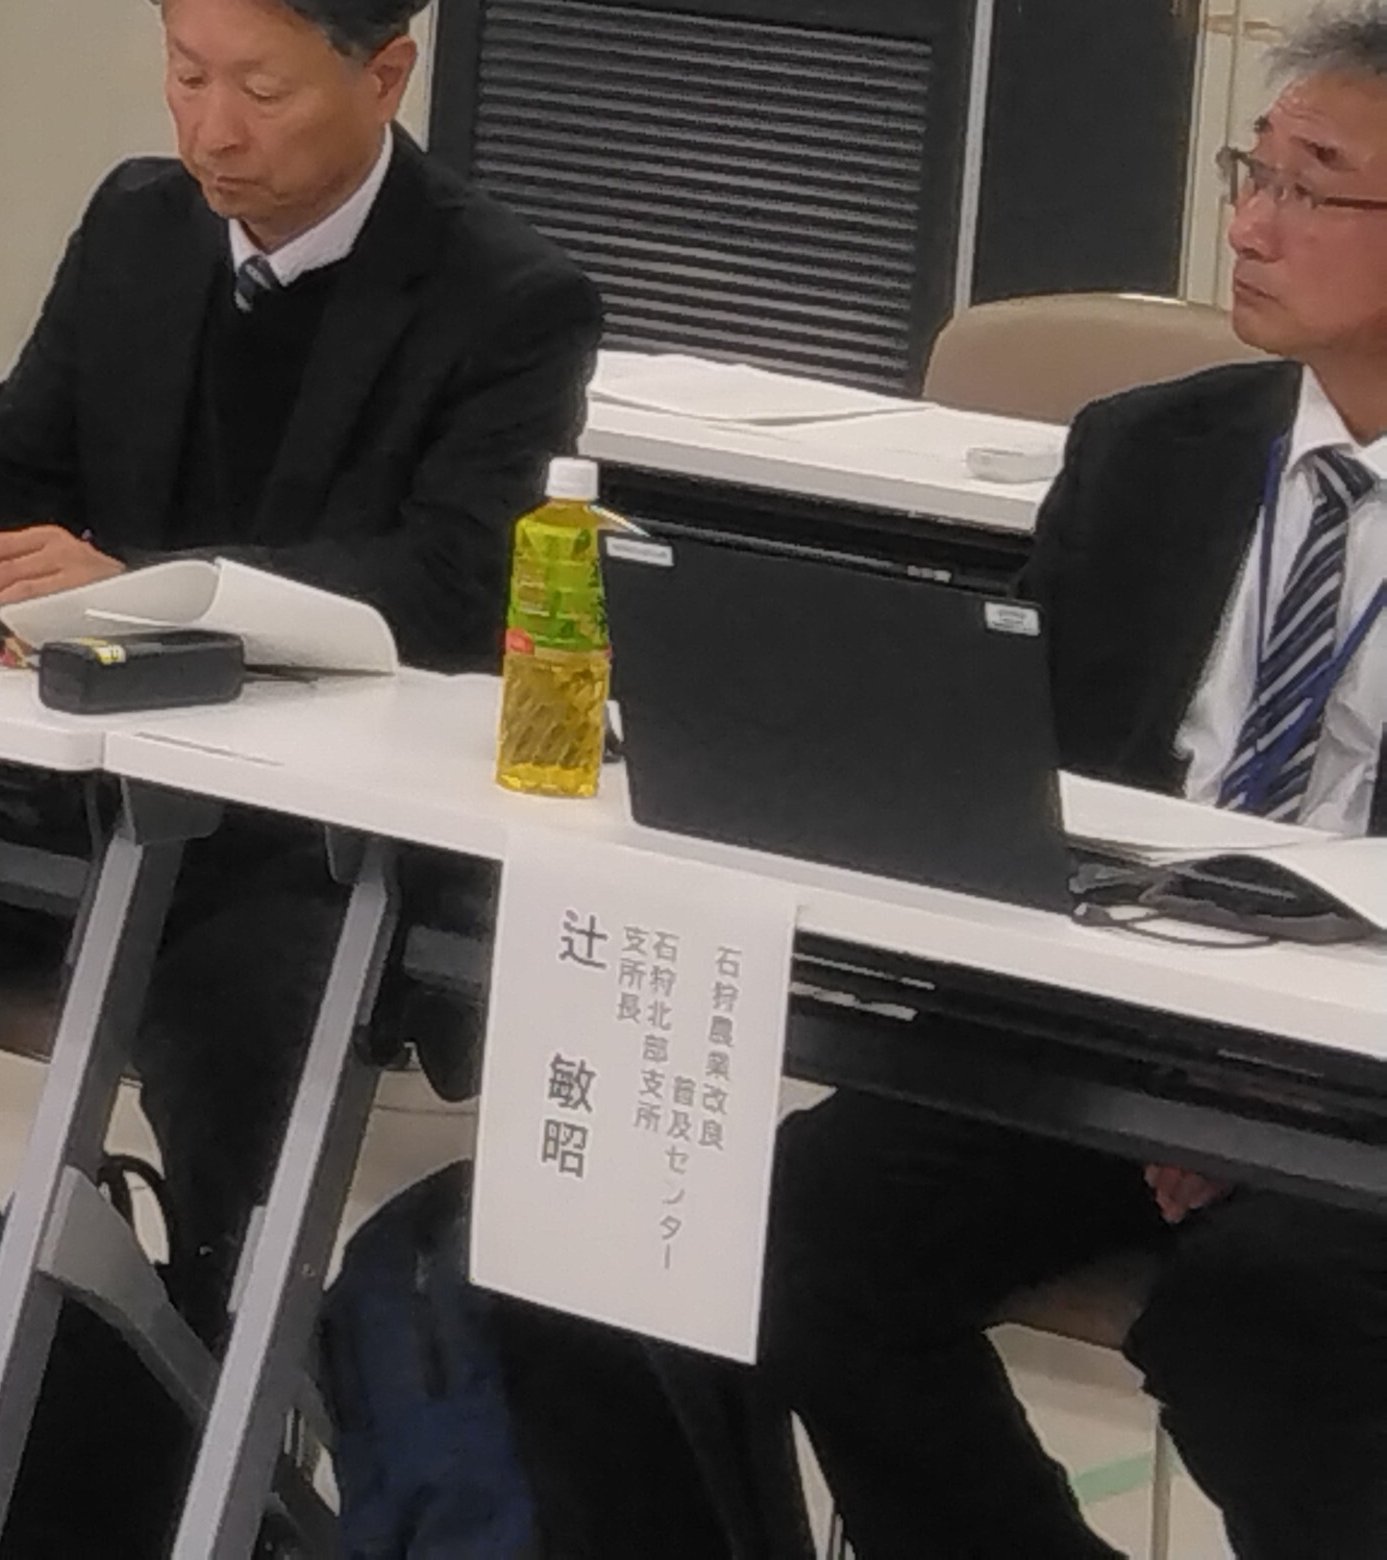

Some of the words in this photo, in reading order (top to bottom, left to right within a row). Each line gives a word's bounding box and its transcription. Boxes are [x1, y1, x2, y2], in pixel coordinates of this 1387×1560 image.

[558, 908, 610, 972] 辻
[615, 925, 650, 1024] 支所長
[633, 930, 681, 1136] 石狩北部支所
[698, 944, 743, 1153] 石狩農業改良
[540, 1051, 599, 1179] 敏昭
[659, 1074, 697, 1271] 普及センター
